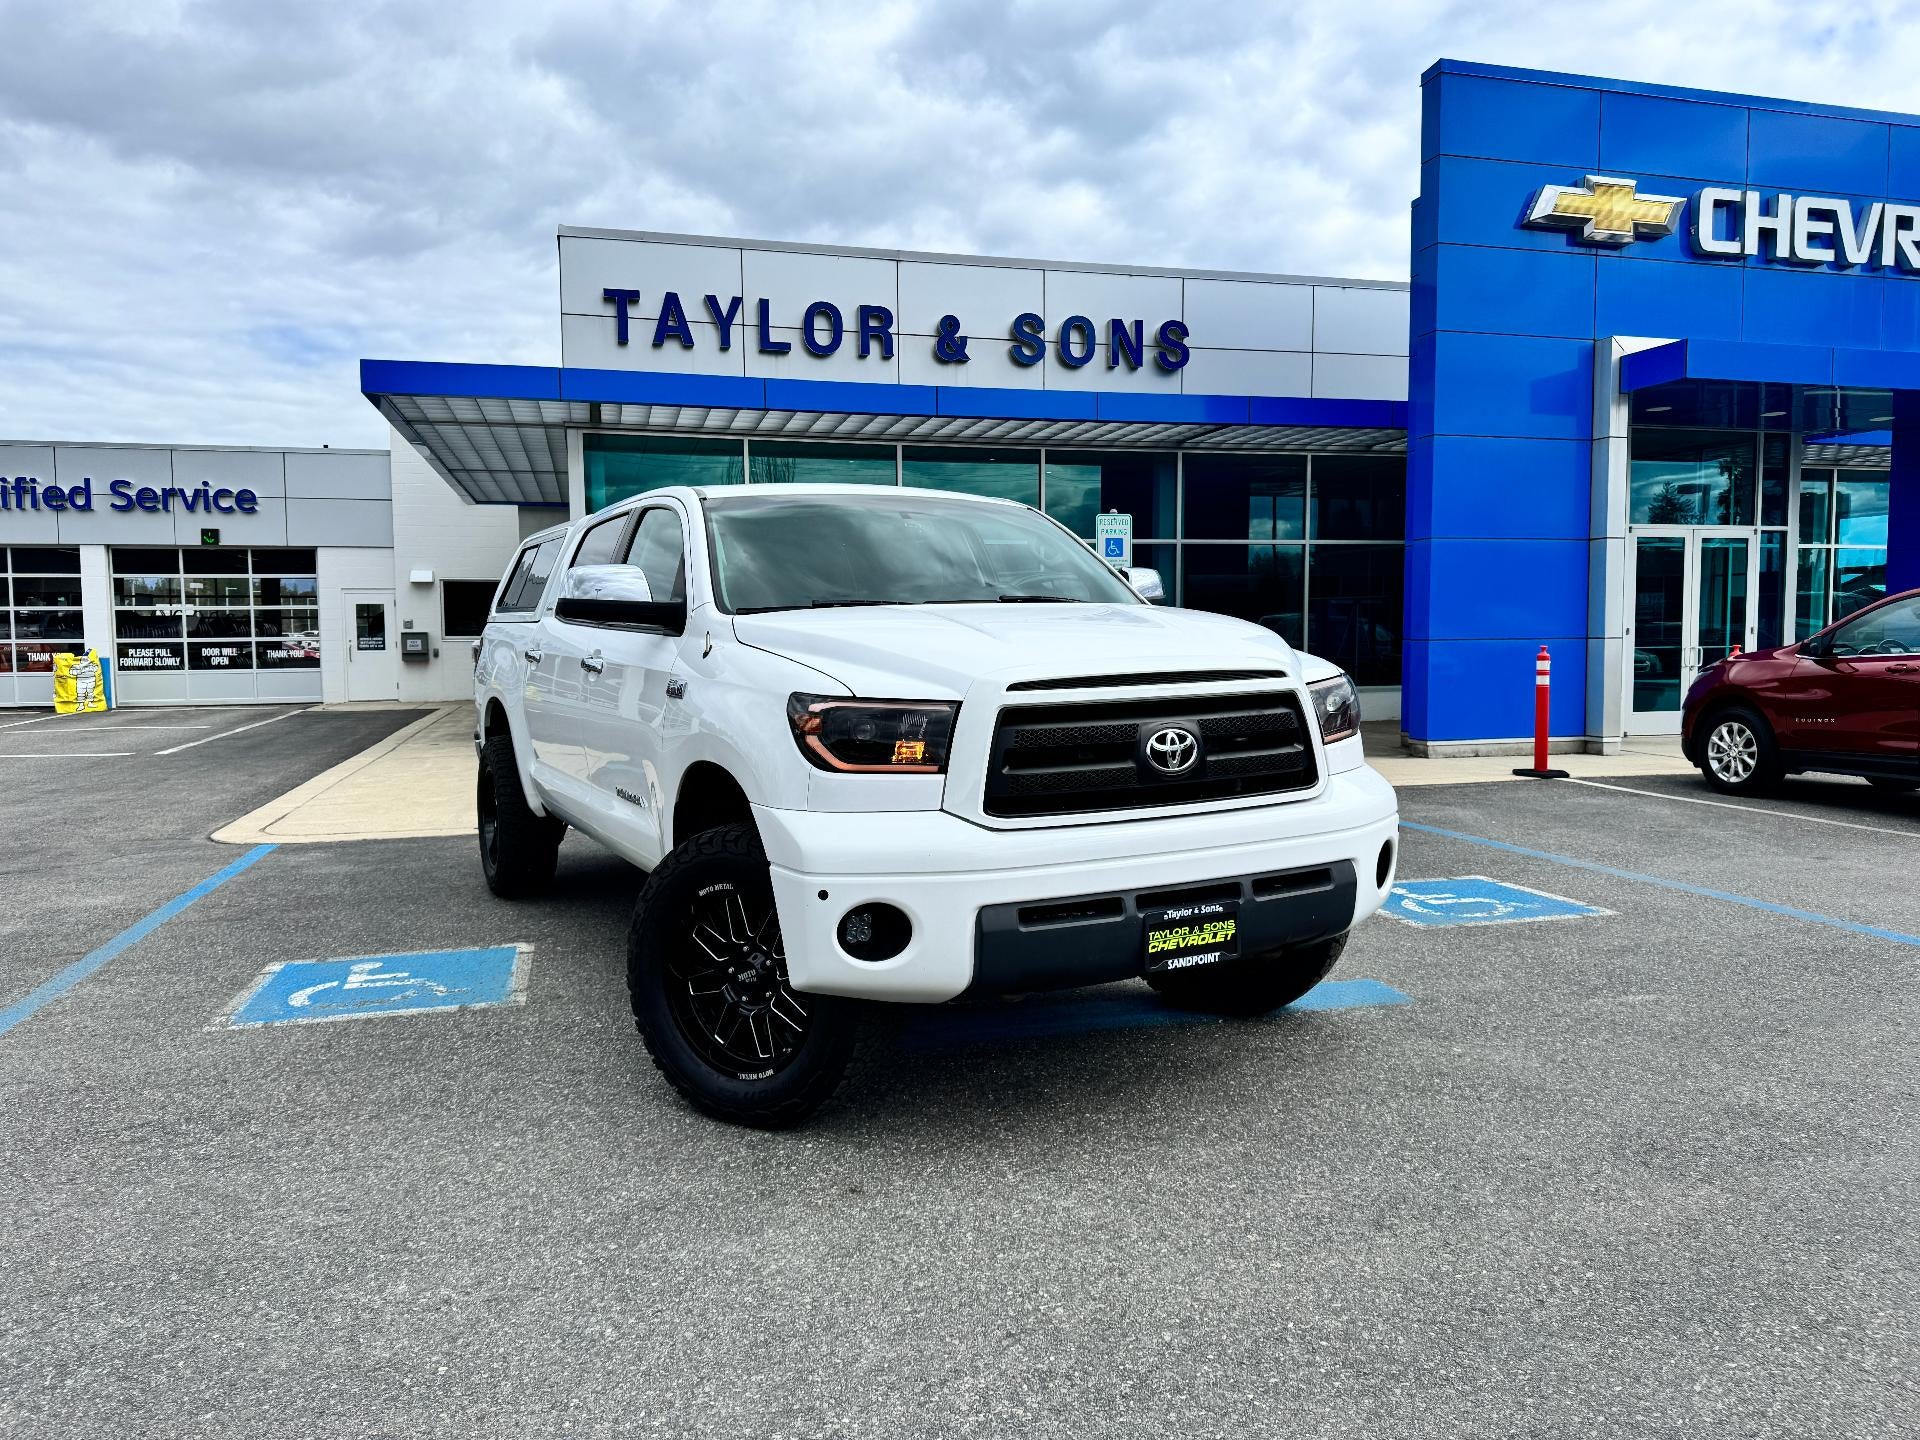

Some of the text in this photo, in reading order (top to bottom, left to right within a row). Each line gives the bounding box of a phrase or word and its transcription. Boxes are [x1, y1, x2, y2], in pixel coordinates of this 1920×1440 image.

[1696, 186, 1920, 268] CHEVR
[602, 288, 1190, 370] TAYLOR & SONS
[0, 476, 258, 513] ified Service
[1099, 518, 1129, 526] RESERVED
[27, 652, 51, 662] THANK
[128, 649, 172, 658] PLEASE PULL
[201, 648, 238, 657] DOOR WILL
[266, 650, 288, 659] THANK
[119, 657, 181, 667] FORWARD SLOWLY
[210, 657, 229, 666] OPEN
[1167, 909, 1193, 920] Taylor
[1149, 920, 1235, 940] TAYLOR & SONS
[1148, 930, 1236, 954] CHEVROLET
[1167, 952, 1221, 970] SANDPOINT
